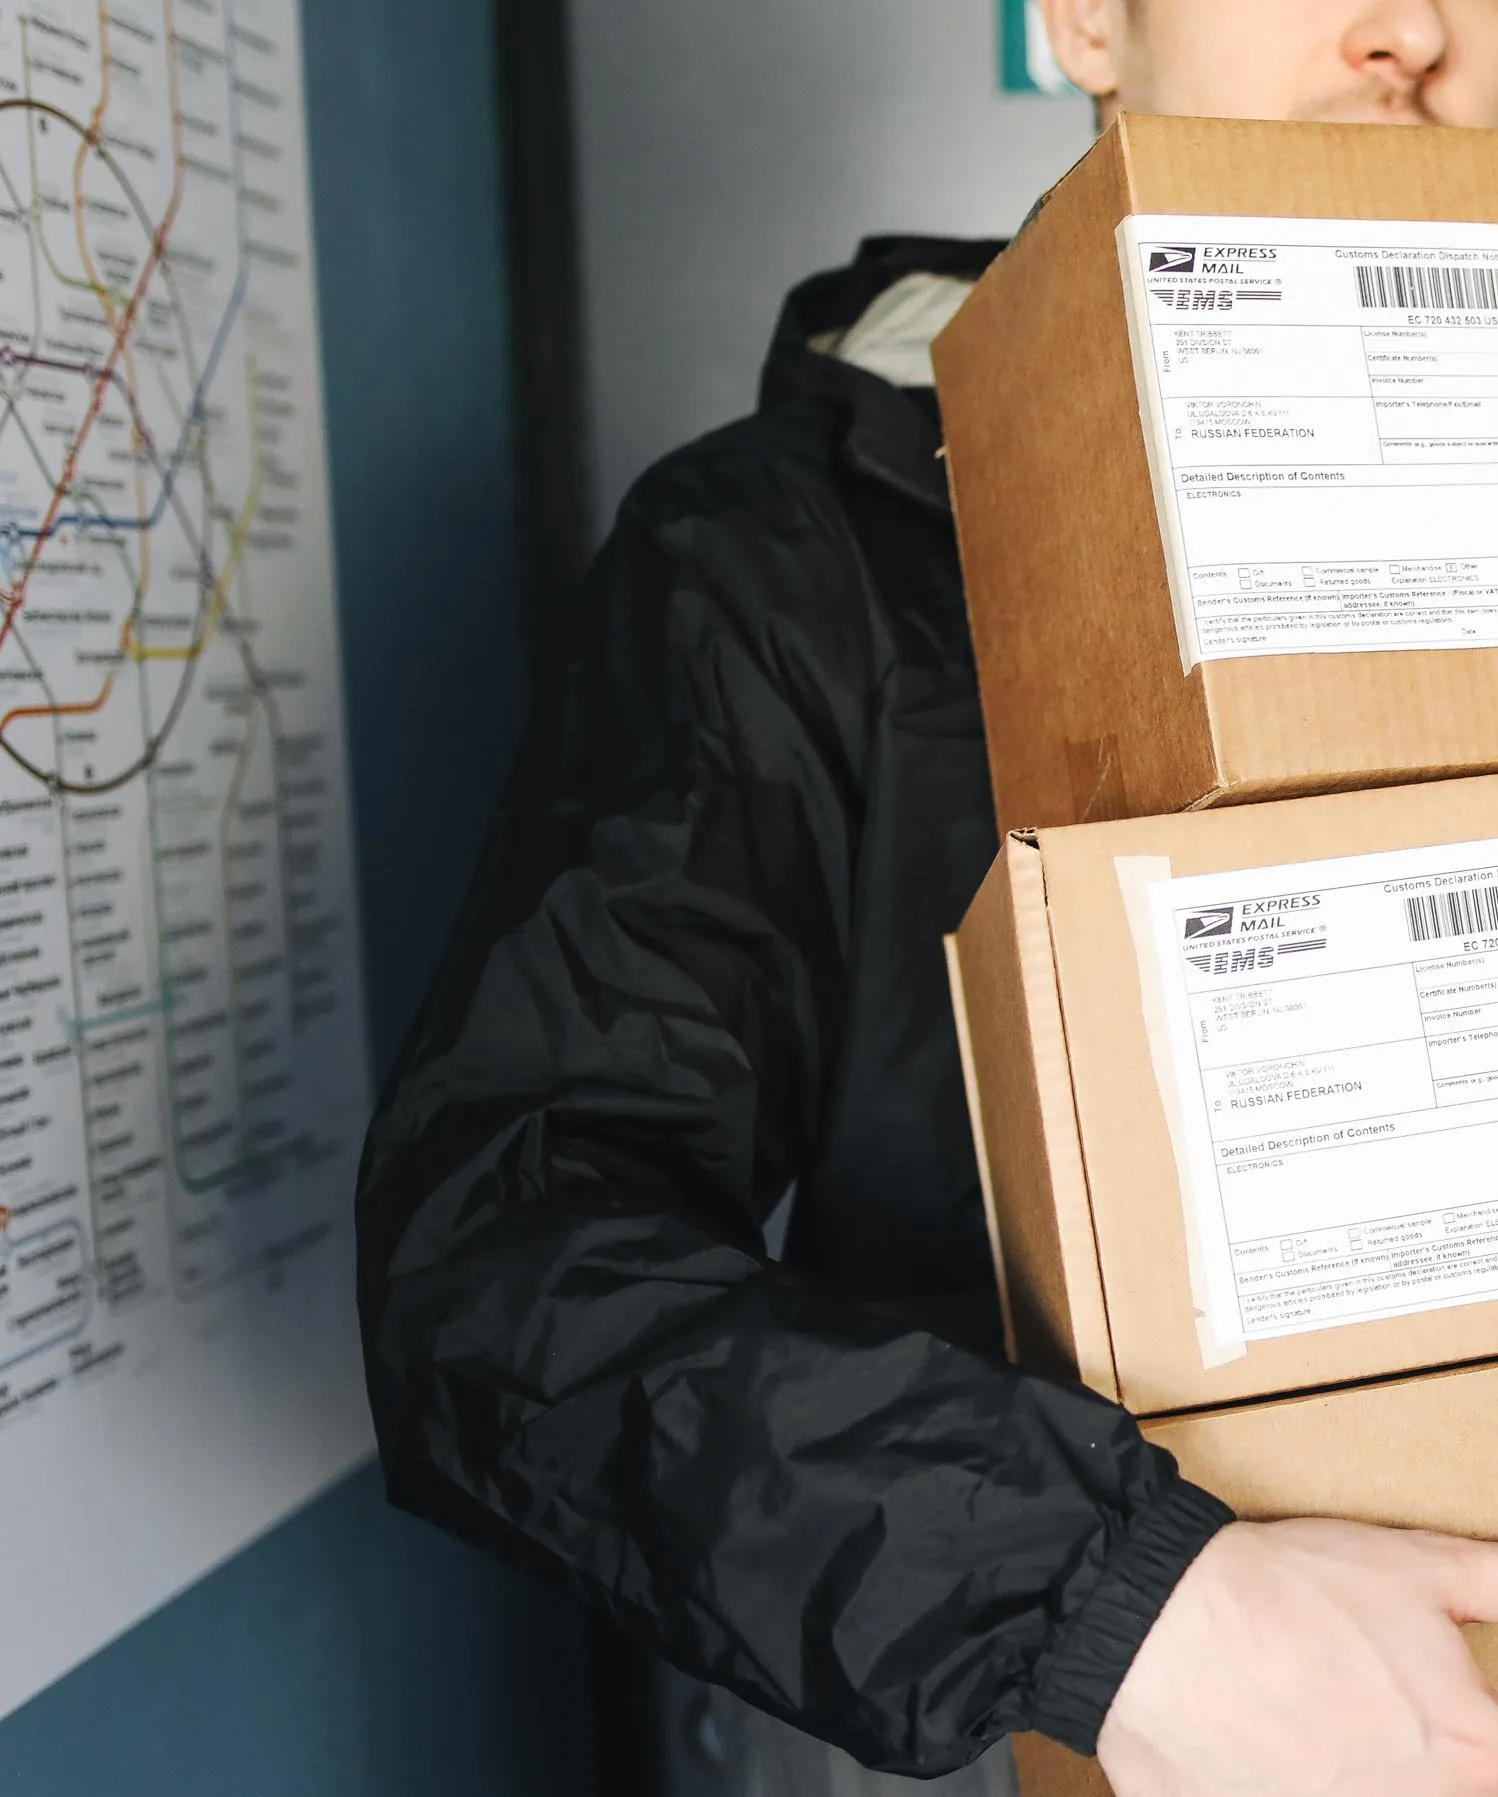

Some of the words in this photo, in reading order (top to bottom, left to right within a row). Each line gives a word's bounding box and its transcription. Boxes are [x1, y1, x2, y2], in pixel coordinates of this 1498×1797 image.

[1202, 247, 1278, 259] EXPRESS
[1334, 249, 1380, 259] Customs
[1381, 250, 1436, 259] Declaration
[1438, 250, 1480, 261] Dispatch
[1200, 263, 1244, 274] MAIL
[1174, 289, 1234, 311] EMS
[1407, 314, 1422, 325] EC
[1424, 315, 1442, 325] 720
[1444, 315, 1463, 325] 432
[1464, 315, 1483, 325] 503
[1484, 315, 1498, 326] US
[1162, 350, 1171, 373] From
[1191, 428, 1242, 439] RUSSIAN
[1244, 427, 1315, 438] FEDERATION
[1181, 473, 1224, 483] Detailed
[1226, 471, 1284, 482] Description
[1287, 471, 1298, 481] of
[1300, 471, 1345, 481] Contents
[1187, 490, 1242, 500] ELECTRONICS
[1193, 571, 1228, 579] Contents
[1232, 596, 1266, 604] Customs
[1378, 591, 1411, 599] Customs
[1383, 880, 1432, 894] Customs
[1434, 872, 1494, 887] Declaration
[1240, 894, 1322, 915] EXPRESS
[1239, 917, 1286, 932] MAIL
[1181, 941, 1216, 952] UNITED
[1216, 937, 1247, 946] STATES
[1247, 933, 1280, 942] POSTAL
[1280, 927, 1317, 937] SERVICE
[1463, 940, 1479, 952] EC
[1211, 946, 1276, 975] EMS
[1415, 963, 1445, 973] License
[1445, 958, 1485, 968] Number(s)
[1419, 987, 1457, 999] Certificate
[1458, 982, 1497, 992] Number(s)
[1423, 1013, 1452, 1022] Invoice
[1452, 1008, 1482, 1017] Number
[1199, 1019, 1209, 1044] From
[1428, 1035, 1467, 1047] Importer's
[1230, 1093, 1284, 1108] RUSSIAN
[1286, 1081, 1363, 1100] FEDERATION
[1220, 1142, 1265, 1158] Detailed
[1267, 1134, 1330, 1150] Description
[1332, 1129, 1345, 1140] of
[1346, 1123, 1396, 1138] Contents
[1226, 1159, 1284, 1174] ELECTRONICS
[1367, 1235, 1400, 1246] Returned
[1400, 1232, 1423, 1242] goods
[1233, 1245, 1270, 1256] Contents
[1390, 1247, 1430, 1258] Importer's
[1431, 1241, 1465, 1252] Customs
[1442, 1250, 1471, 1259] known)
[1274, 1267, 1310, 1278] Customs
[1310, 1260, 1350, 1271] Reference
[1360, 1254, 1389, 1264] known)
